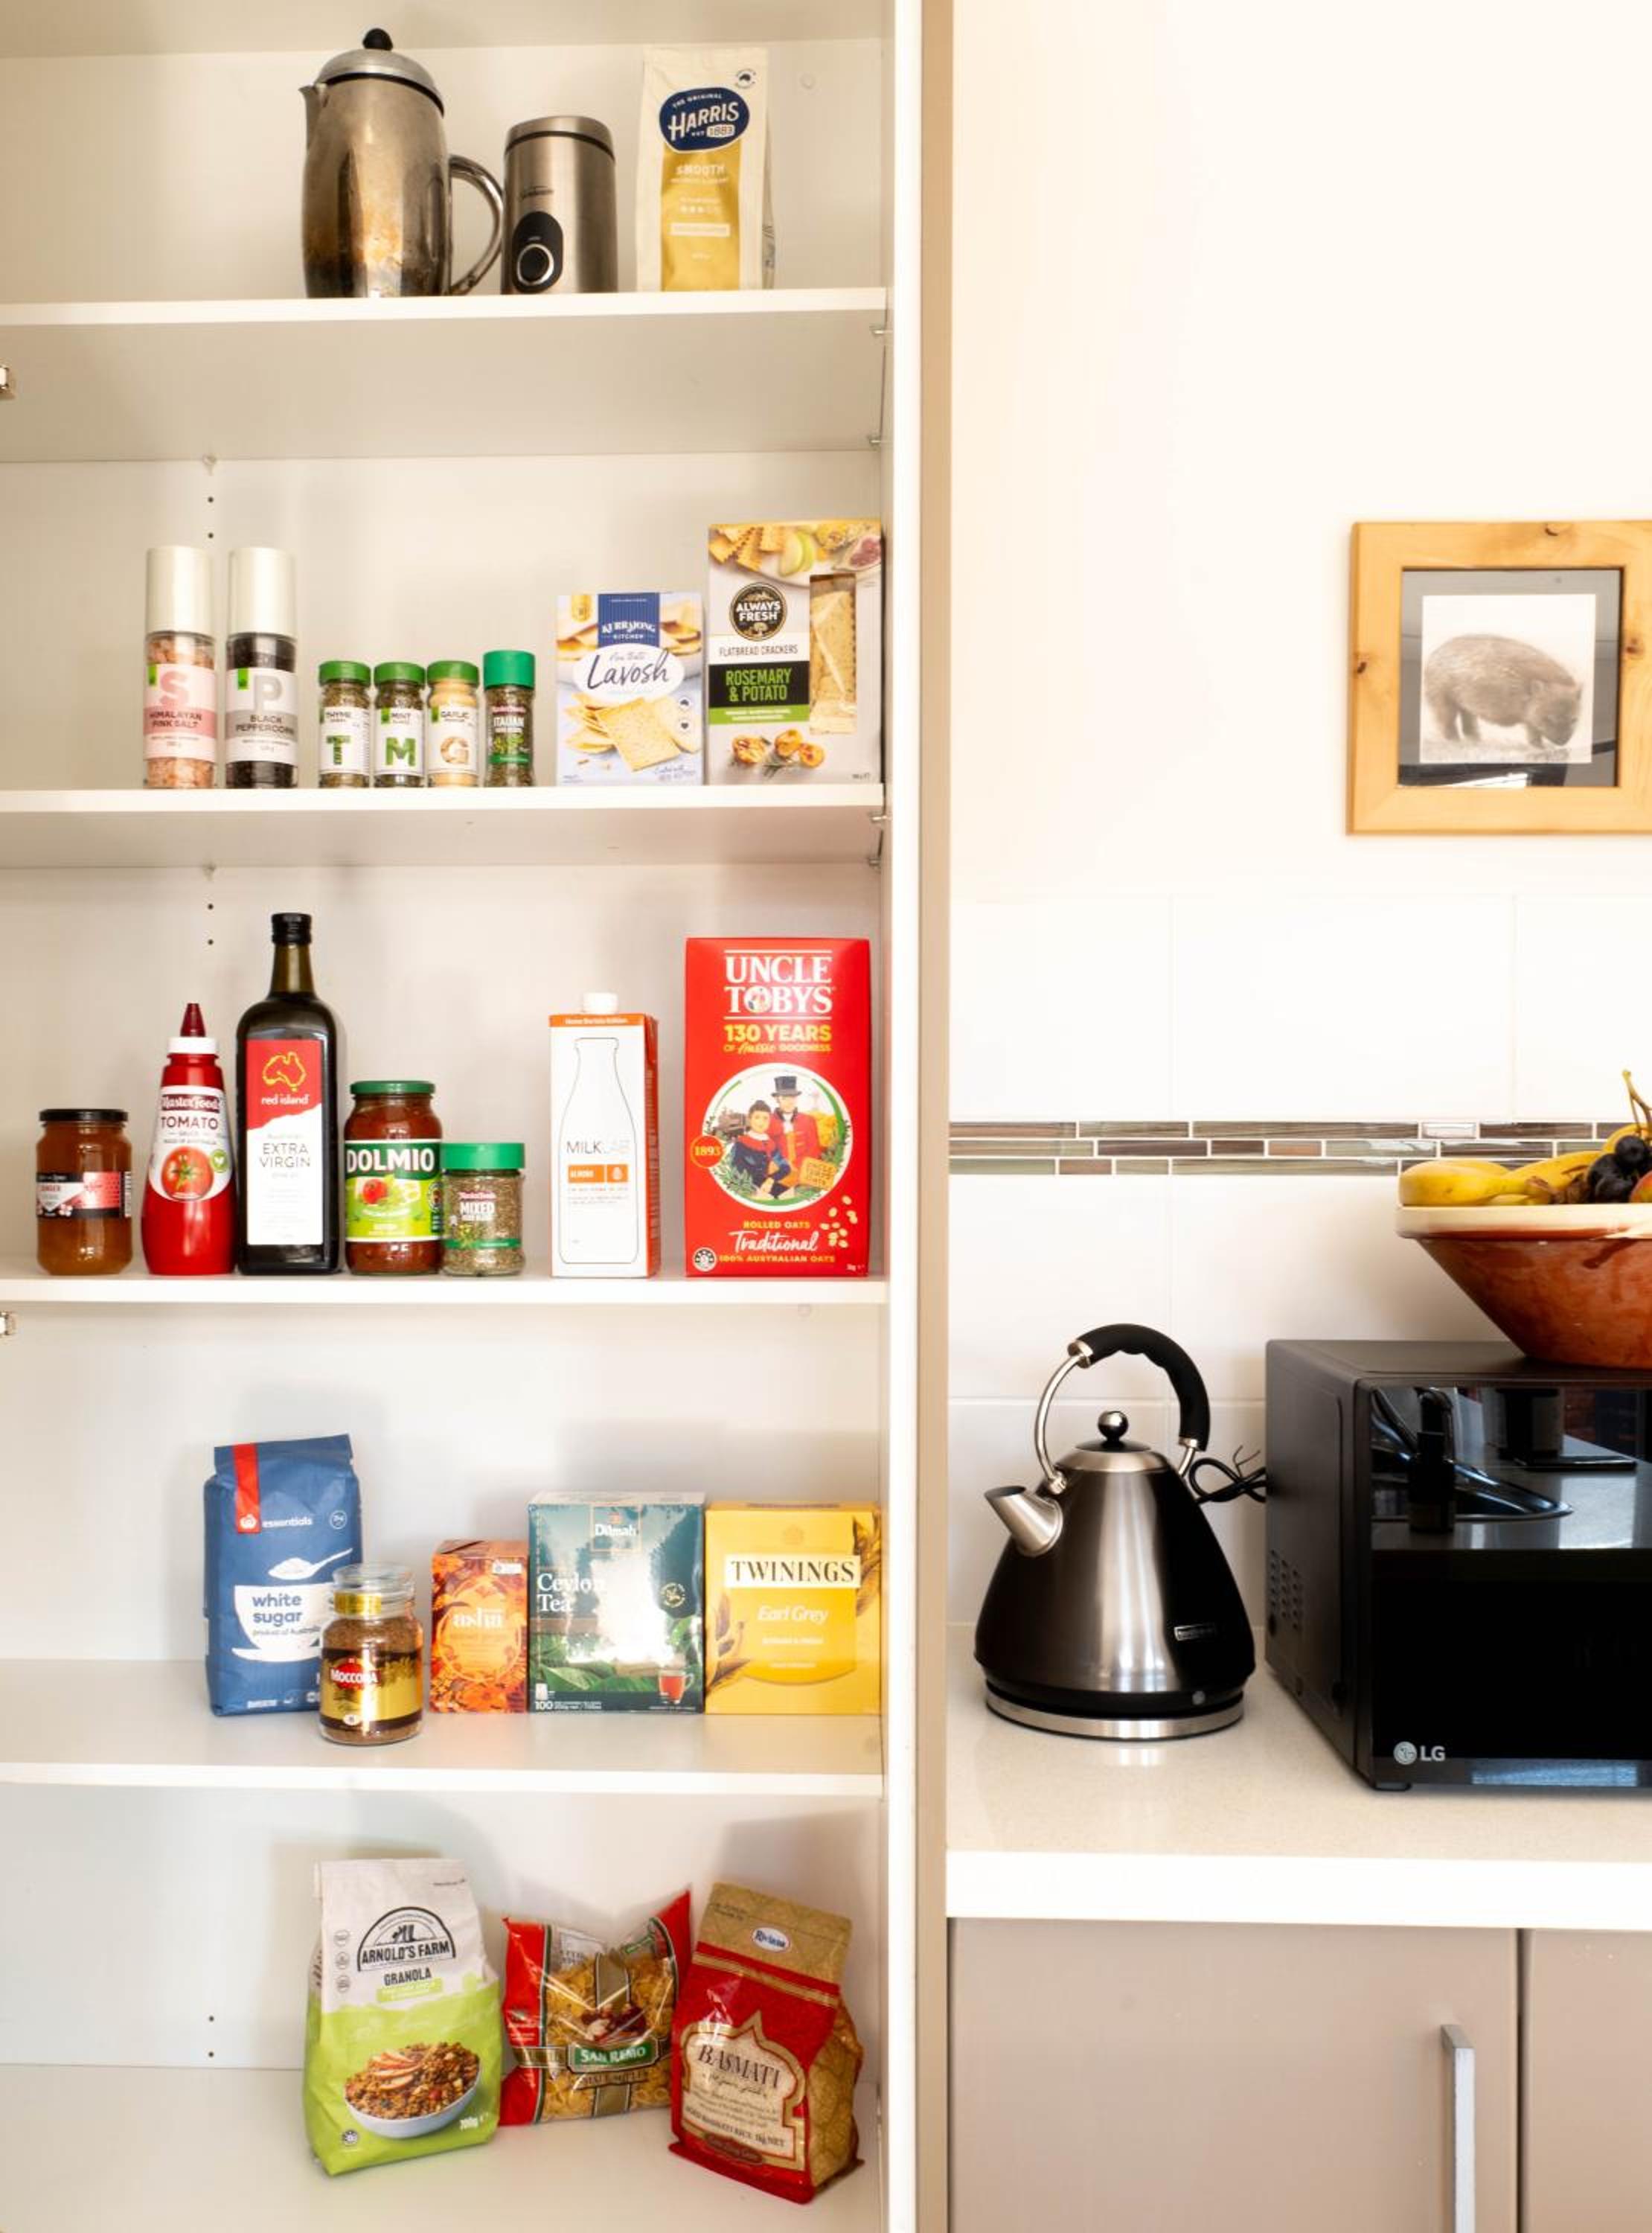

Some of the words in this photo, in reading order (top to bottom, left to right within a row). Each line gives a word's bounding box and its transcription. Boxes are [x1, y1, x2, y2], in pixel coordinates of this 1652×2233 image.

[668, 101, 739, 141] HARRIS
[736, 601, 781, 612] ALWAYS
[739, 611, 778, 622] FRESH
[601, 621, 656, 633] KURRAJONG
[719, 646, 759, 657] FLATBREAD
[761, 644, 798, 655] CRACKERS
[587, 648, 669, 689] Lavosh
[726, 668, 792, 686] ROSEMARY
[160, 671, 189, 708] S
[254, 675, 282, 712] P
[730, 686, 739, 702] &
[742, 685, 787, 702] POTATO
[150, 711, 202, 721] HIMALAYAN
[153, 719, 173, 727] PINK
[174, 719, 198, 728] SALT
[250, 715, 282, 723] BLACK
[326, 735, 351, 765] T
[385, 738, 416, 767] M
[441, 737, 469, 764] G
[725, 956, 833, 983] UNCLE
[723, 985, 833, 1014] TOBYS
[724, 1023, 761, 1042] 130
[764, 1023, 833, 1042] YEARS
[261, 1093, 278, 1105] red
[280, 1093, 310, 1105] island
[161, 1116, 218, 1130] TOMATO
[263, 1143, 309, 1154] EXTRA
[259, 1157, 310, 1168] VIRGIN
[346, 1148, 435, 1173] DOLMIO
[460, 1201, 495, 1215] MIXED
[743, 1221, 781, 1229] ROLLED
[784, 1221, 810, 1229] OATS
[728, 1230, 819, 1253] Traditional
[731, 1560, 855, 1582] TWININGS
[252, 1593, 302, 1607] white
[537, 1594, 572, 1612] Tea
[253, 1611, 302, 1627] sugar
[758, 1605, 790, 1620] Earl
[792, 1605, 830, 1626] Grey
[330, 1668, 378, 1684] MOCCOA
[535, 1701, 554, 1710] 100
[1420, 1745, 1446, 1762] LG
[362, 1945, 416, 1964] ARNOLD'S
[418, 1940, 450, 1957] FARM
[384, 1967, 432, 1986] GRANOLA
[698, 2044, 781, 2089] BASMATI
